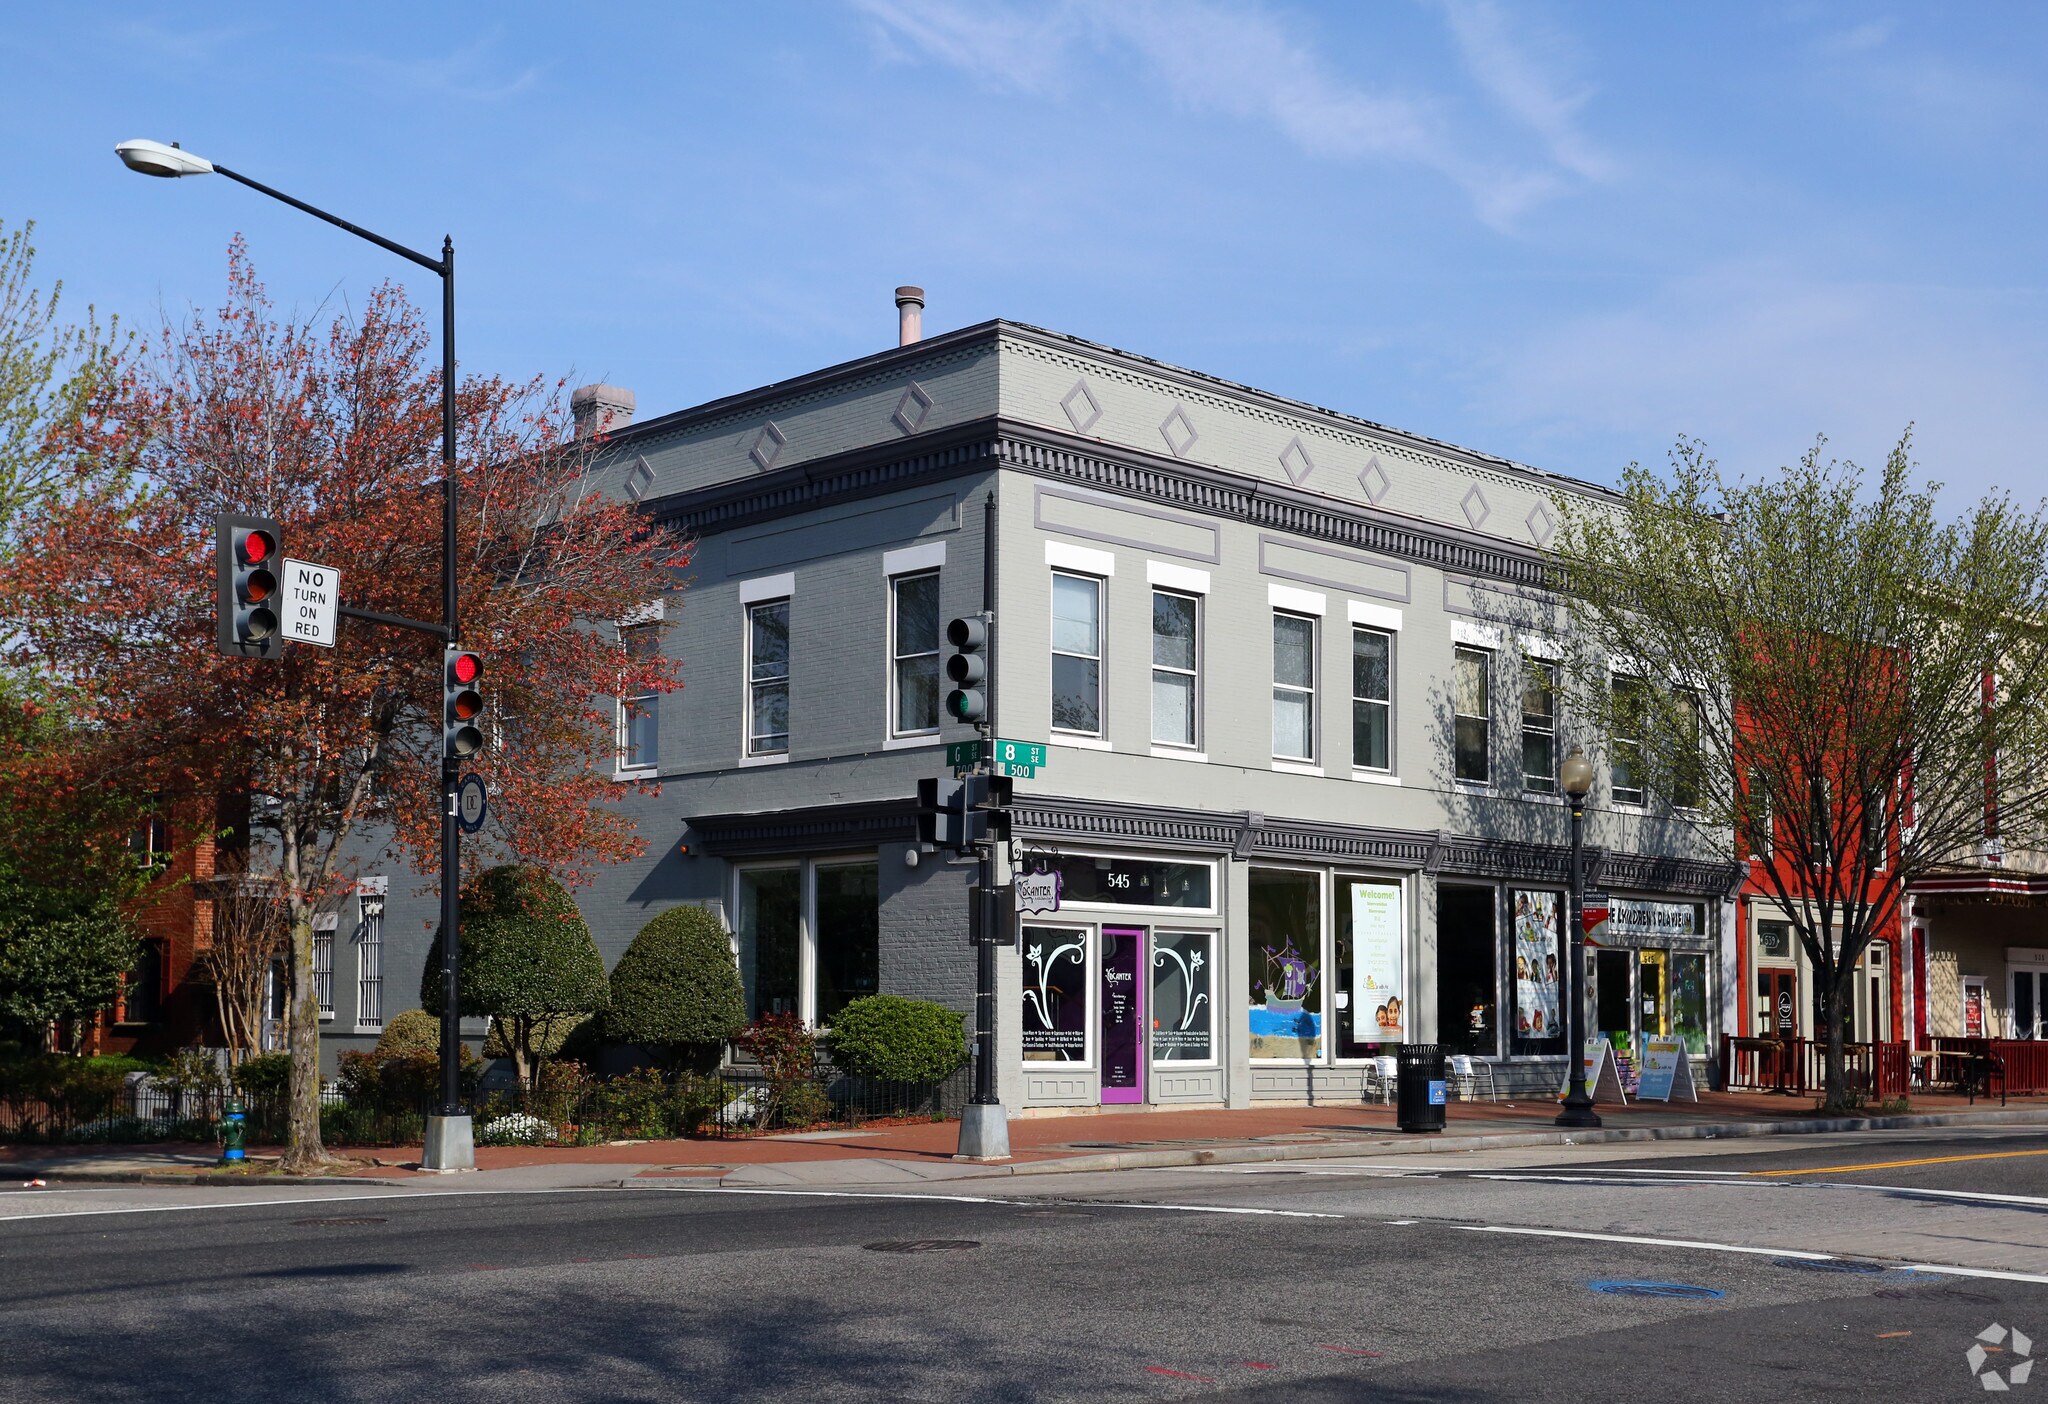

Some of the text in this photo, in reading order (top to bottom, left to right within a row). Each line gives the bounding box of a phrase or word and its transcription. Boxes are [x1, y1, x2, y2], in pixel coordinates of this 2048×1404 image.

[299, 569, 324, 587] NO
[294, 587, 326, 605] TURN
[300, 606, 317, 620] ON
[295, 621, 320, 637] RED
[954, 743, 977, 762] G ST
[971, 752, 977, 760] SE
[1005, 744, 1040, 761] 8 ST
[1031, 755, 1039, 763] SE
[1011, 764, 1029, 778] 500
[1108, 872, 1130, 889] 545
[1359, 889, 1395, 900] Welcome!
[1764, 935, 1776, 946] 539
